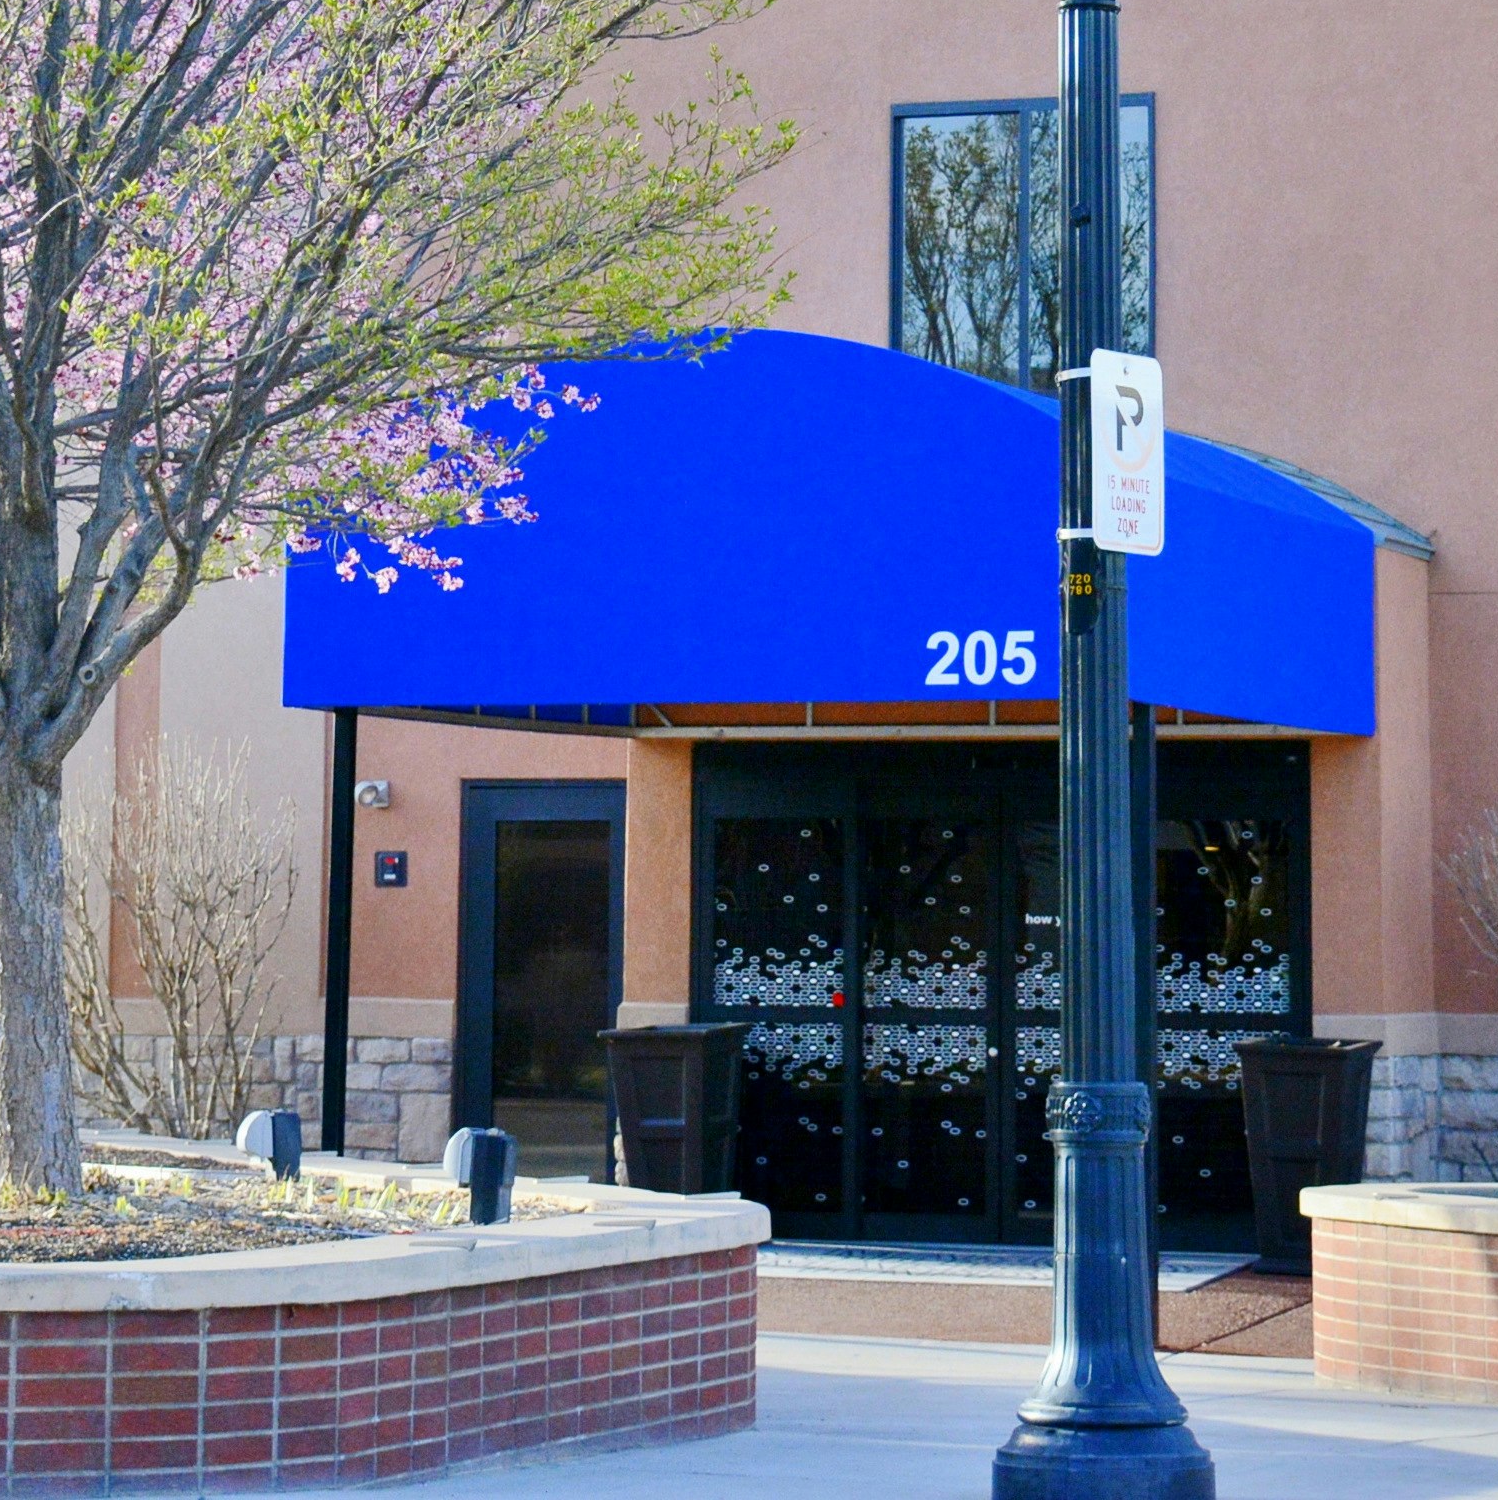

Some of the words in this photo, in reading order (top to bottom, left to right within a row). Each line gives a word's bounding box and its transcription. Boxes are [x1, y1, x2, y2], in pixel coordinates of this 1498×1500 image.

[1107, 474, 1116, 490] 15
[1121, 477, 1150, 495] MINUTE
[1111, 495, 1146, 514] LOADING
[1117, 517, 1139, 535] ZONE
[1068, 573, 1091, 584] 720
[1069, 584, 1092, 596] 780
[924, 629, 1037, 686] 205
[1025, 913, 1052, 925] how
